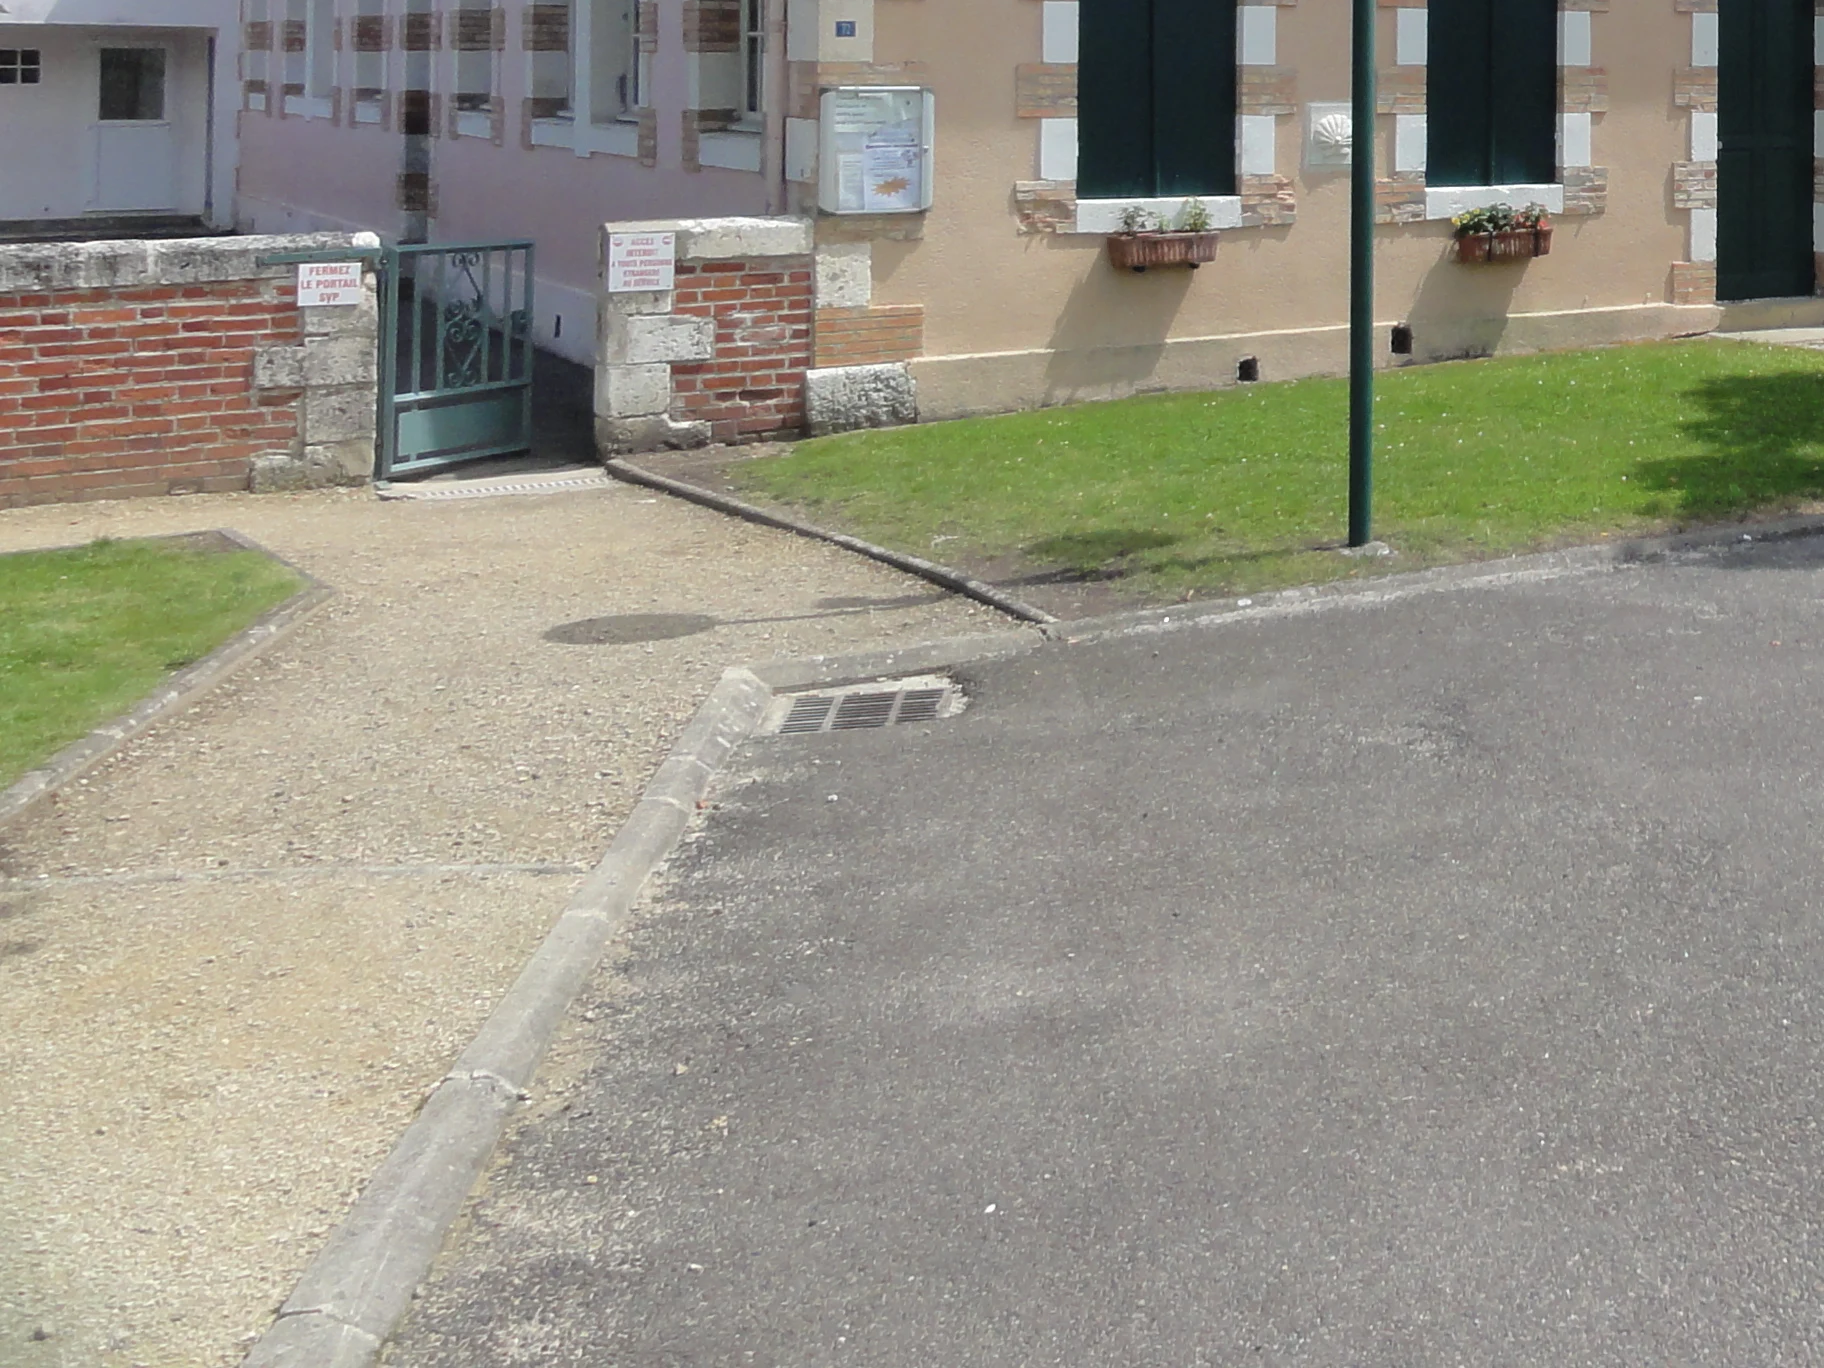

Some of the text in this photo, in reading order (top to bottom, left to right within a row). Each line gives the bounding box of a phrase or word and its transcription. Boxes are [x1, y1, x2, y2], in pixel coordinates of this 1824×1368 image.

[309, 265, 351, 276] FERMEZ
[301, 278, 358, 290] LE PORTAIL
[319, 292, 340, 304] SVP
